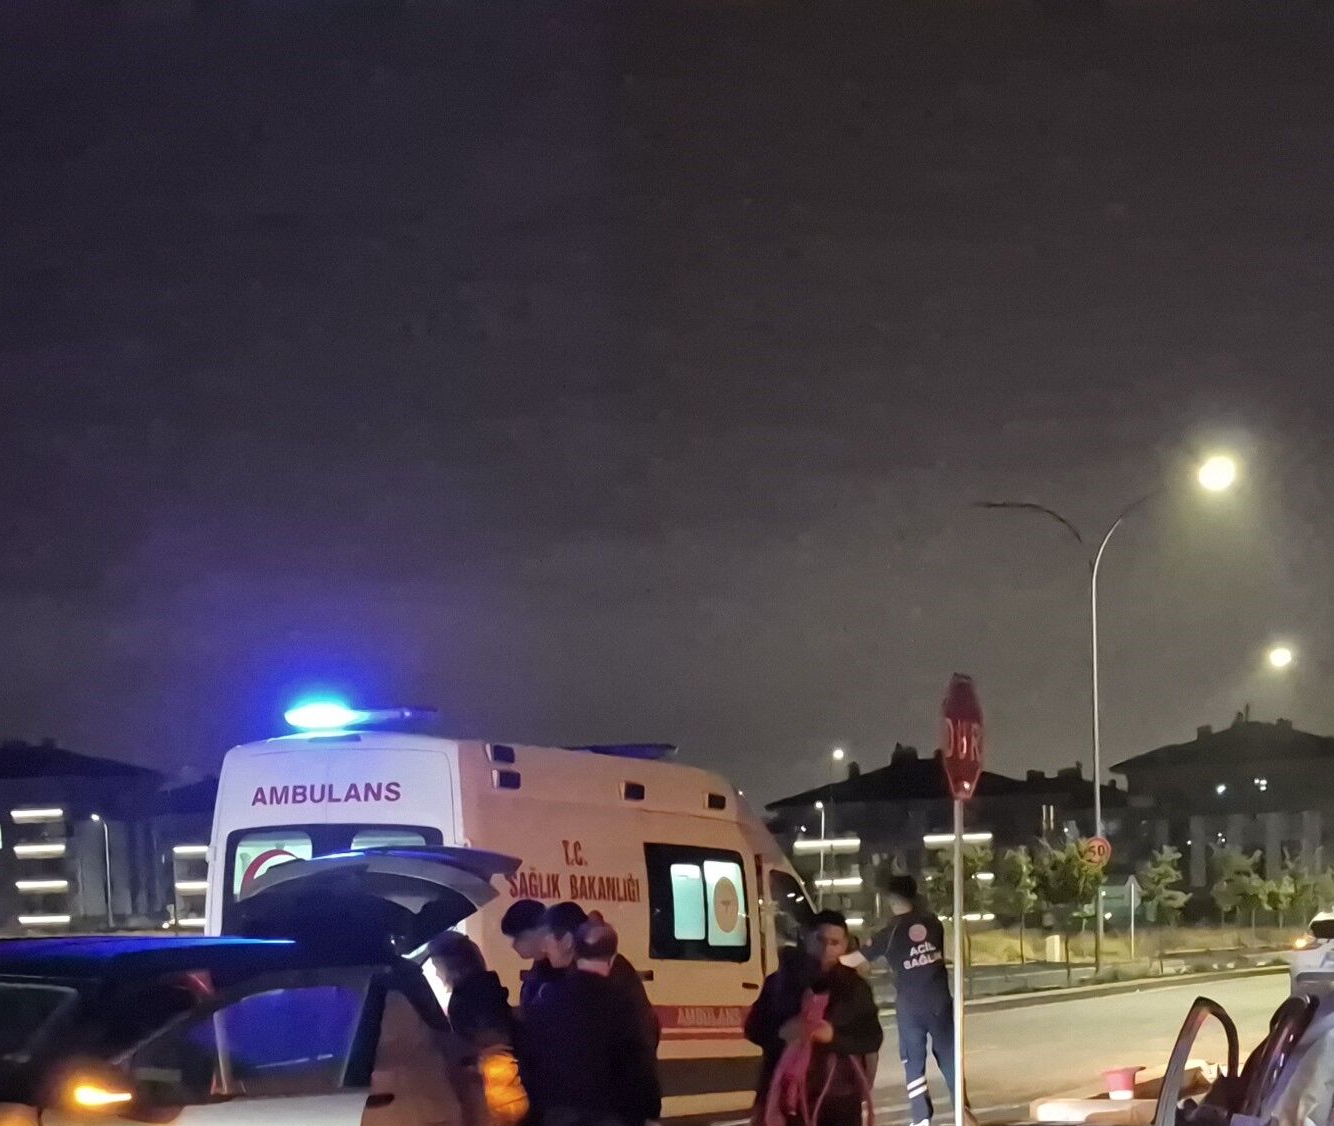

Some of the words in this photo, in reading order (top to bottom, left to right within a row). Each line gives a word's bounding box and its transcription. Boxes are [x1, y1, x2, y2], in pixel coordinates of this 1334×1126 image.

[945, 717, 981, 762] DUR
[251, 781, 401, 806] AMBULANS
[1088, 844, 1105, 857] 50
[506, 866, 561, 899] SAĞLIK
